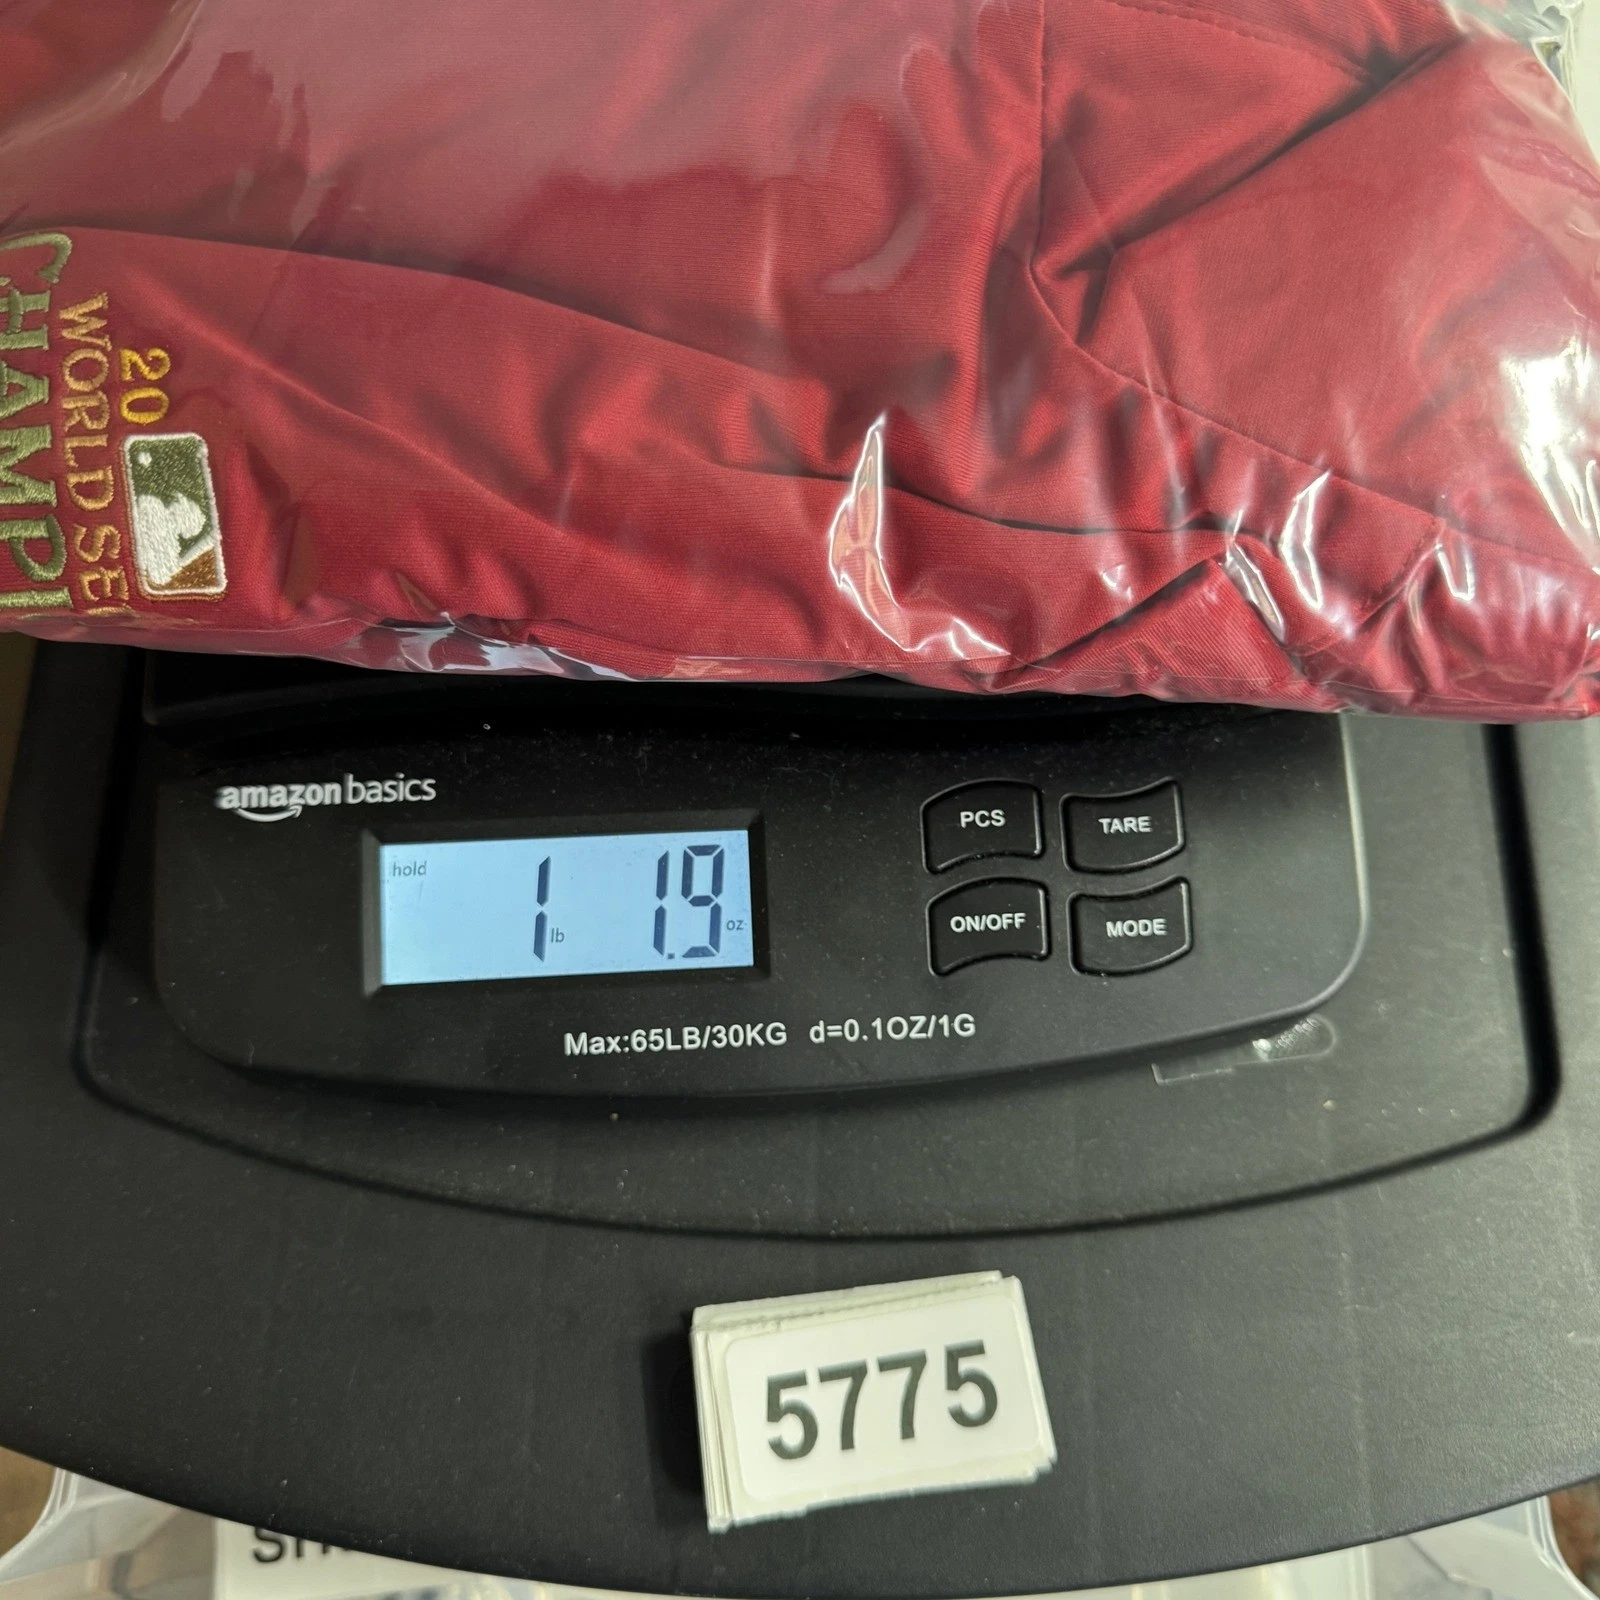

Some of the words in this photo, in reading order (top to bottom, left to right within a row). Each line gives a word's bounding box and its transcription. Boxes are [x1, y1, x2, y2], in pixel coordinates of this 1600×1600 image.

[59, 292, 114, 511] WORLD
[119, 348, 171, 425] 20
[0, 232, 74, 618] CHAMPI
[960, 809, 1006, 828] PCS
[1098, 816, 1153, 834] TARE
[392, 861, 427, 877] hold
[533, 855, 551, 962] 1
[550, 927, 566, 943] lb
[726, 919, 745, 931] oz
[950, 912, 1026, 933] ON/OFF
[1106, 918, 1168, 938] MODE
[563, 1021, 788, 1057] Max:65LB/30KG
[765, 1339, 999, 1460] 5775
